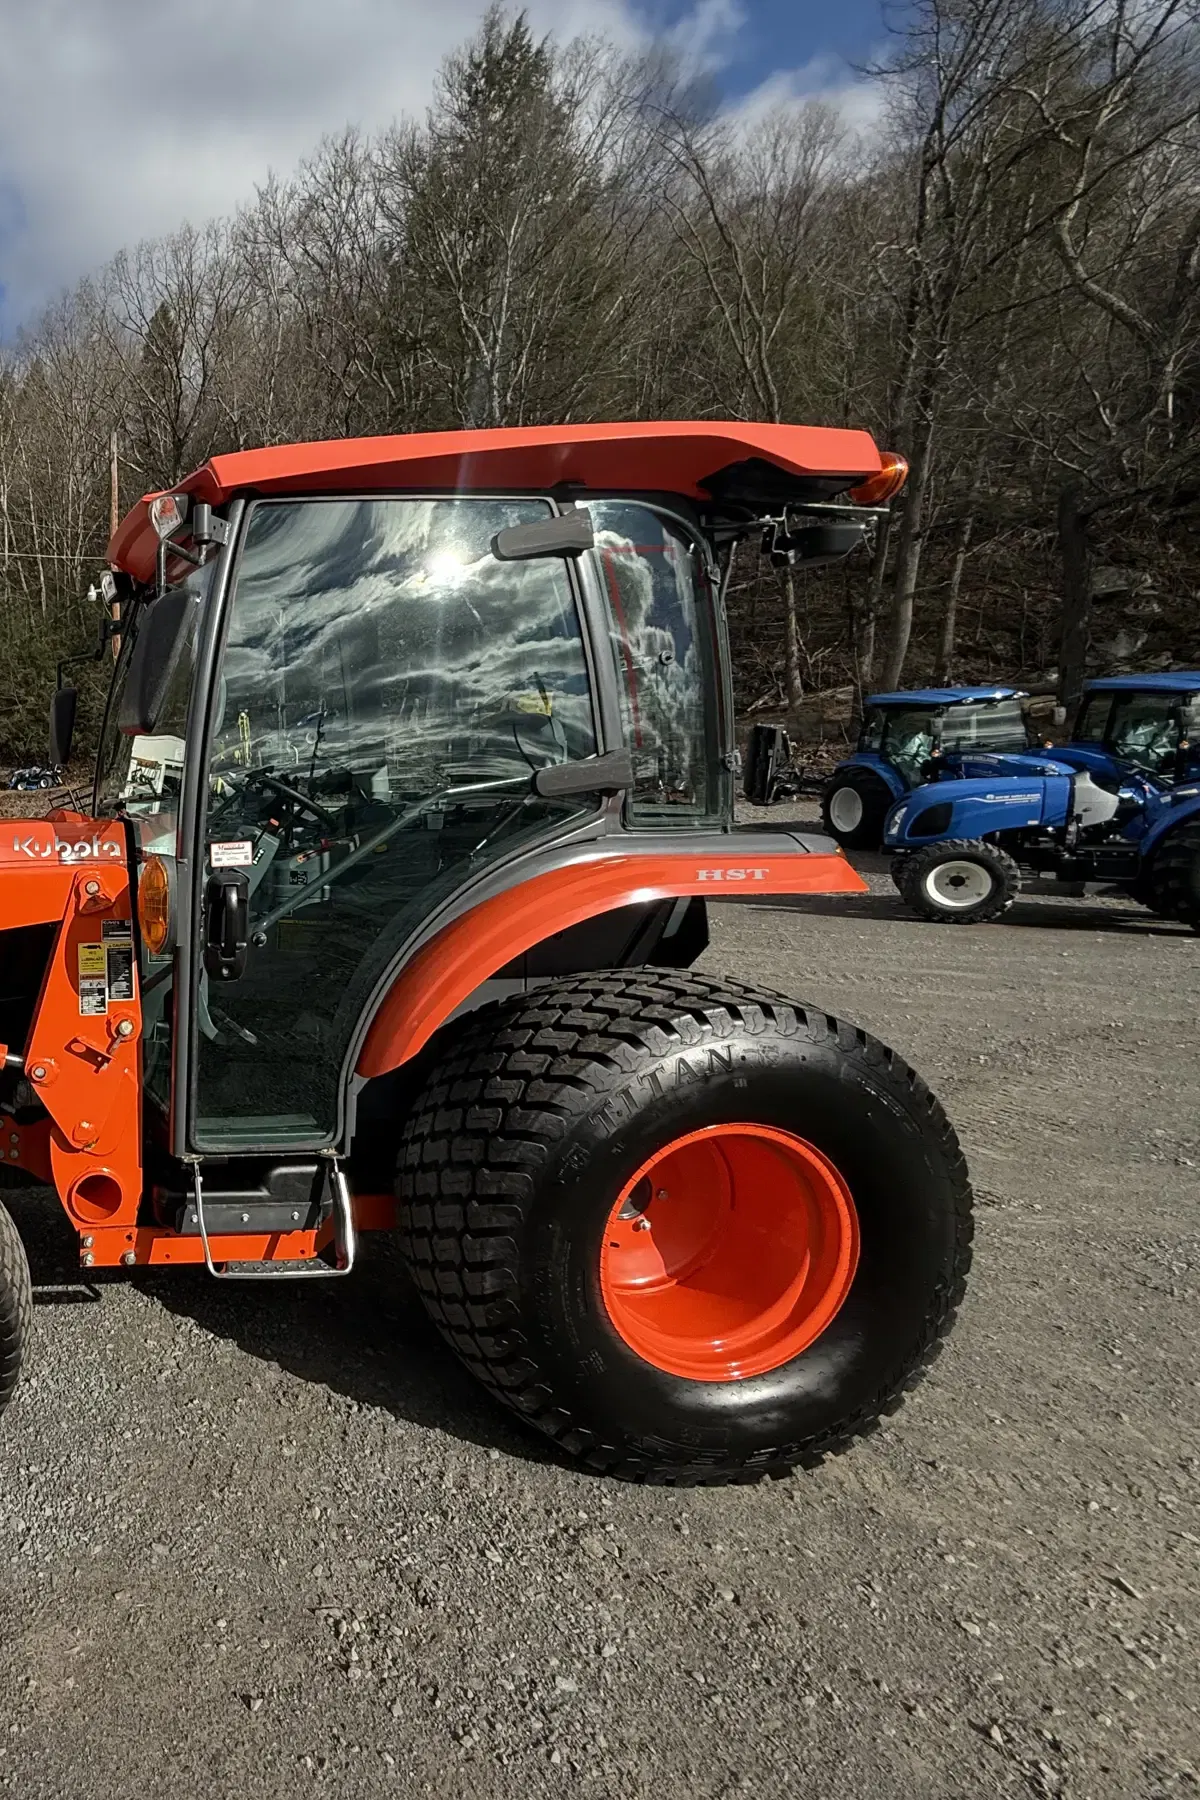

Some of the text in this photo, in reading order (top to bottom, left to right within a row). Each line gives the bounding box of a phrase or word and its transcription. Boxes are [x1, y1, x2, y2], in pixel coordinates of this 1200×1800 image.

[13, 834, 121, 858] Kubota
[695, 868, 770, 881] HST
[587, 1044, 736, 1140] TITAN
